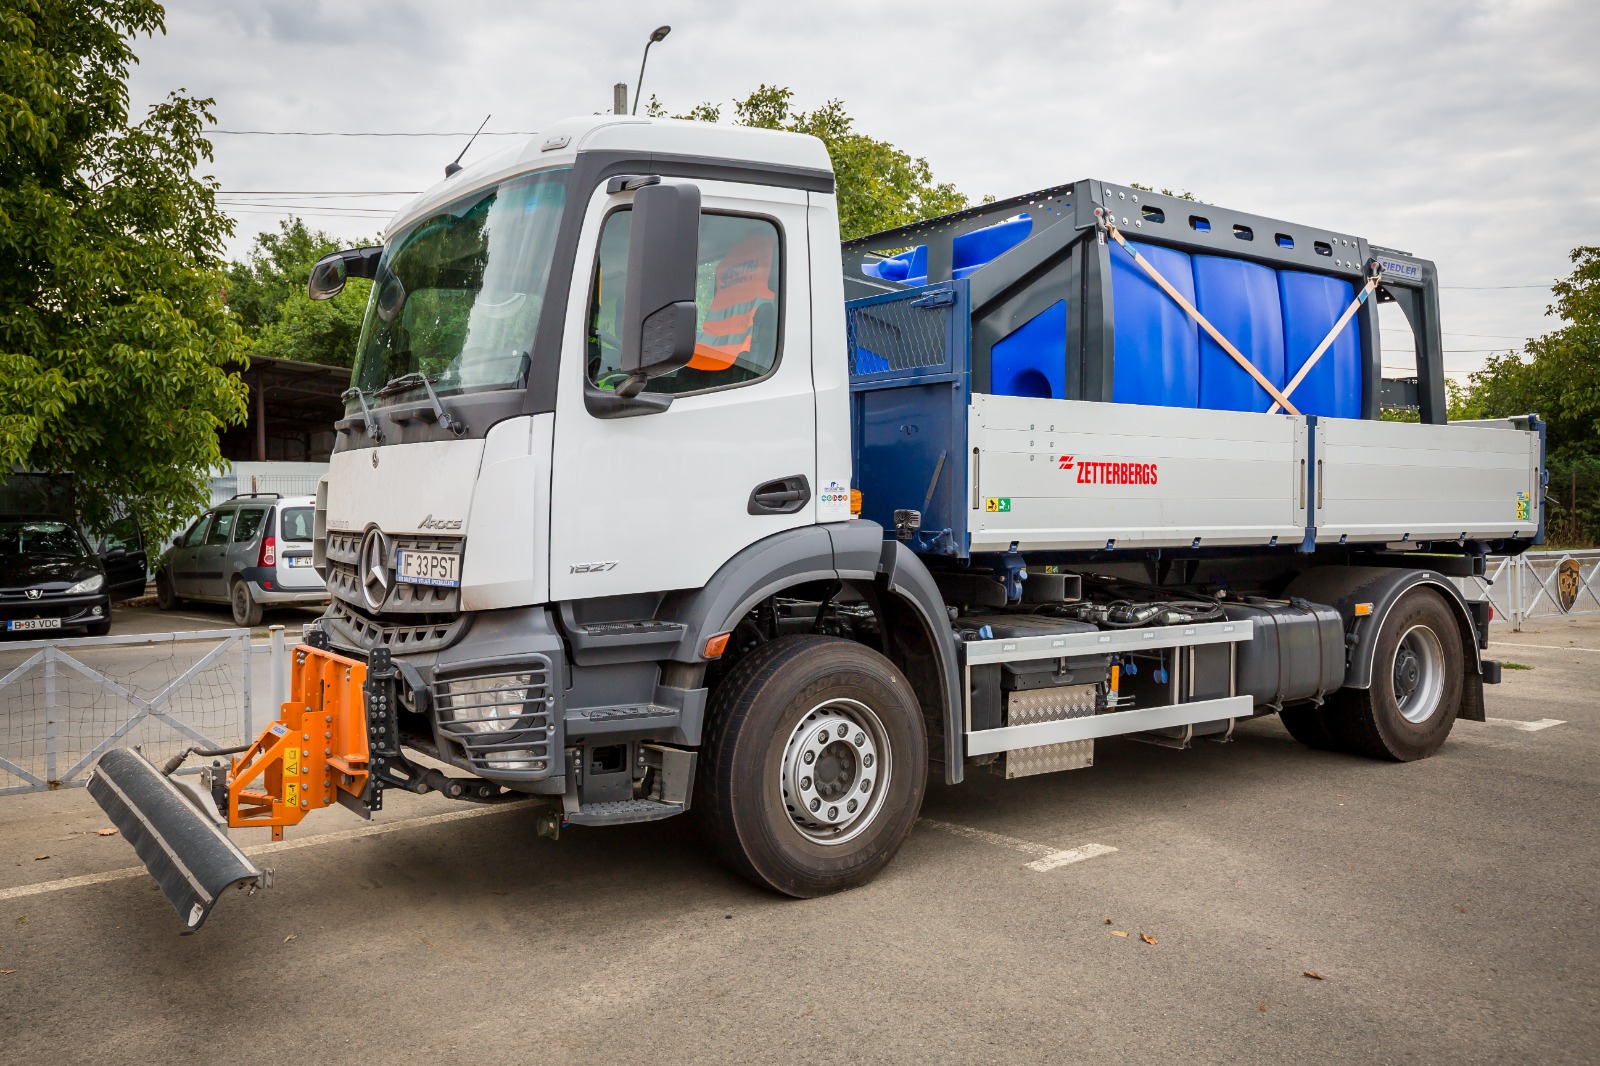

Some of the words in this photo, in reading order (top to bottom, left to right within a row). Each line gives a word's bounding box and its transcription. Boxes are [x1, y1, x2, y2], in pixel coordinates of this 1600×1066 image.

[1076, 461, 1158, 485] ZETTERBERGS
[403, 553, 414, 575] IF
[416, 554, 429, 577] 33
[430, 555, 456, 579] PST
[569, 560, 620, 575] 1827
[14, 621, 21, 630] B
[24, 620, 36, 629] 93
[38, 619, 58, 628] VDC
